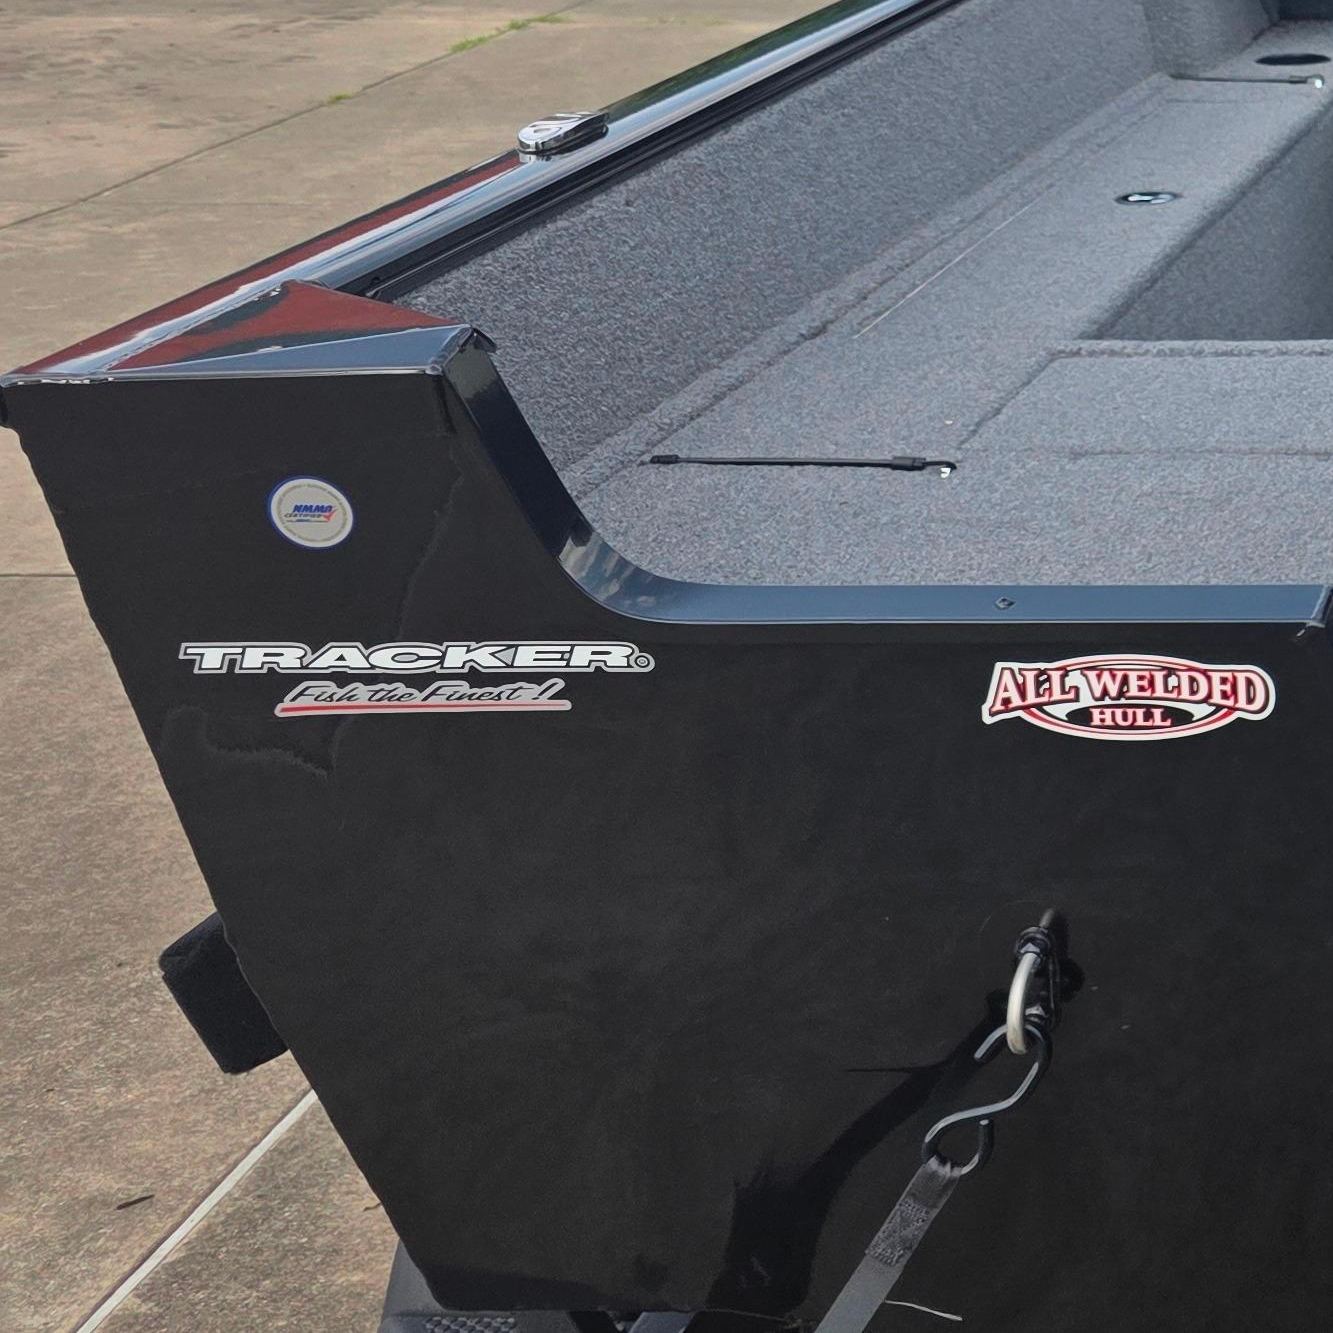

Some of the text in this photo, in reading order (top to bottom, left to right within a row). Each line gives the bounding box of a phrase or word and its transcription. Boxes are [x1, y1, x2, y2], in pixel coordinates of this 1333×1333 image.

[289, 683, 360, 703] Fish
[365, 684, 418, 703] the
[988, 665, 1270, 715] ALL WELDED
[1089, 706, 1172, 728] HULL
